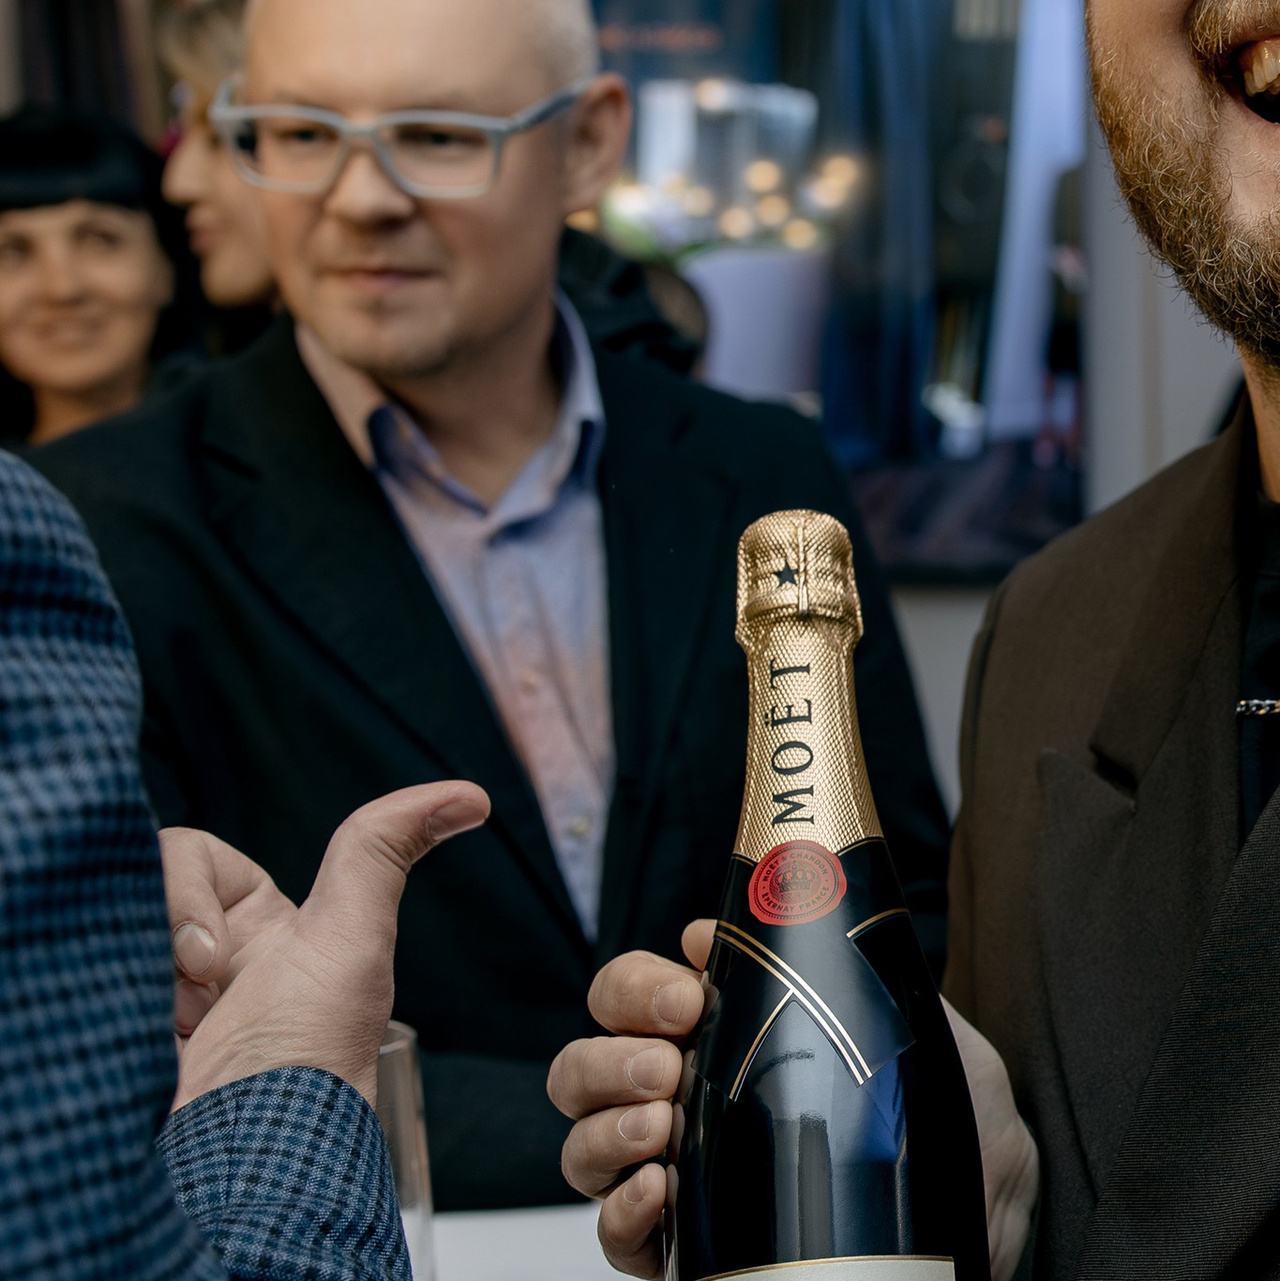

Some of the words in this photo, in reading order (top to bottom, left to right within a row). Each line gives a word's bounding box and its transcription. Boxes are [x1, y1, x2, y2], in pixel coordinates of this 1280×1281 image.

[765, 660, 815, 827] MOËT
[789, 852, 829, 875] CHANDON
[799, 886, 830, 911] FRANCE
